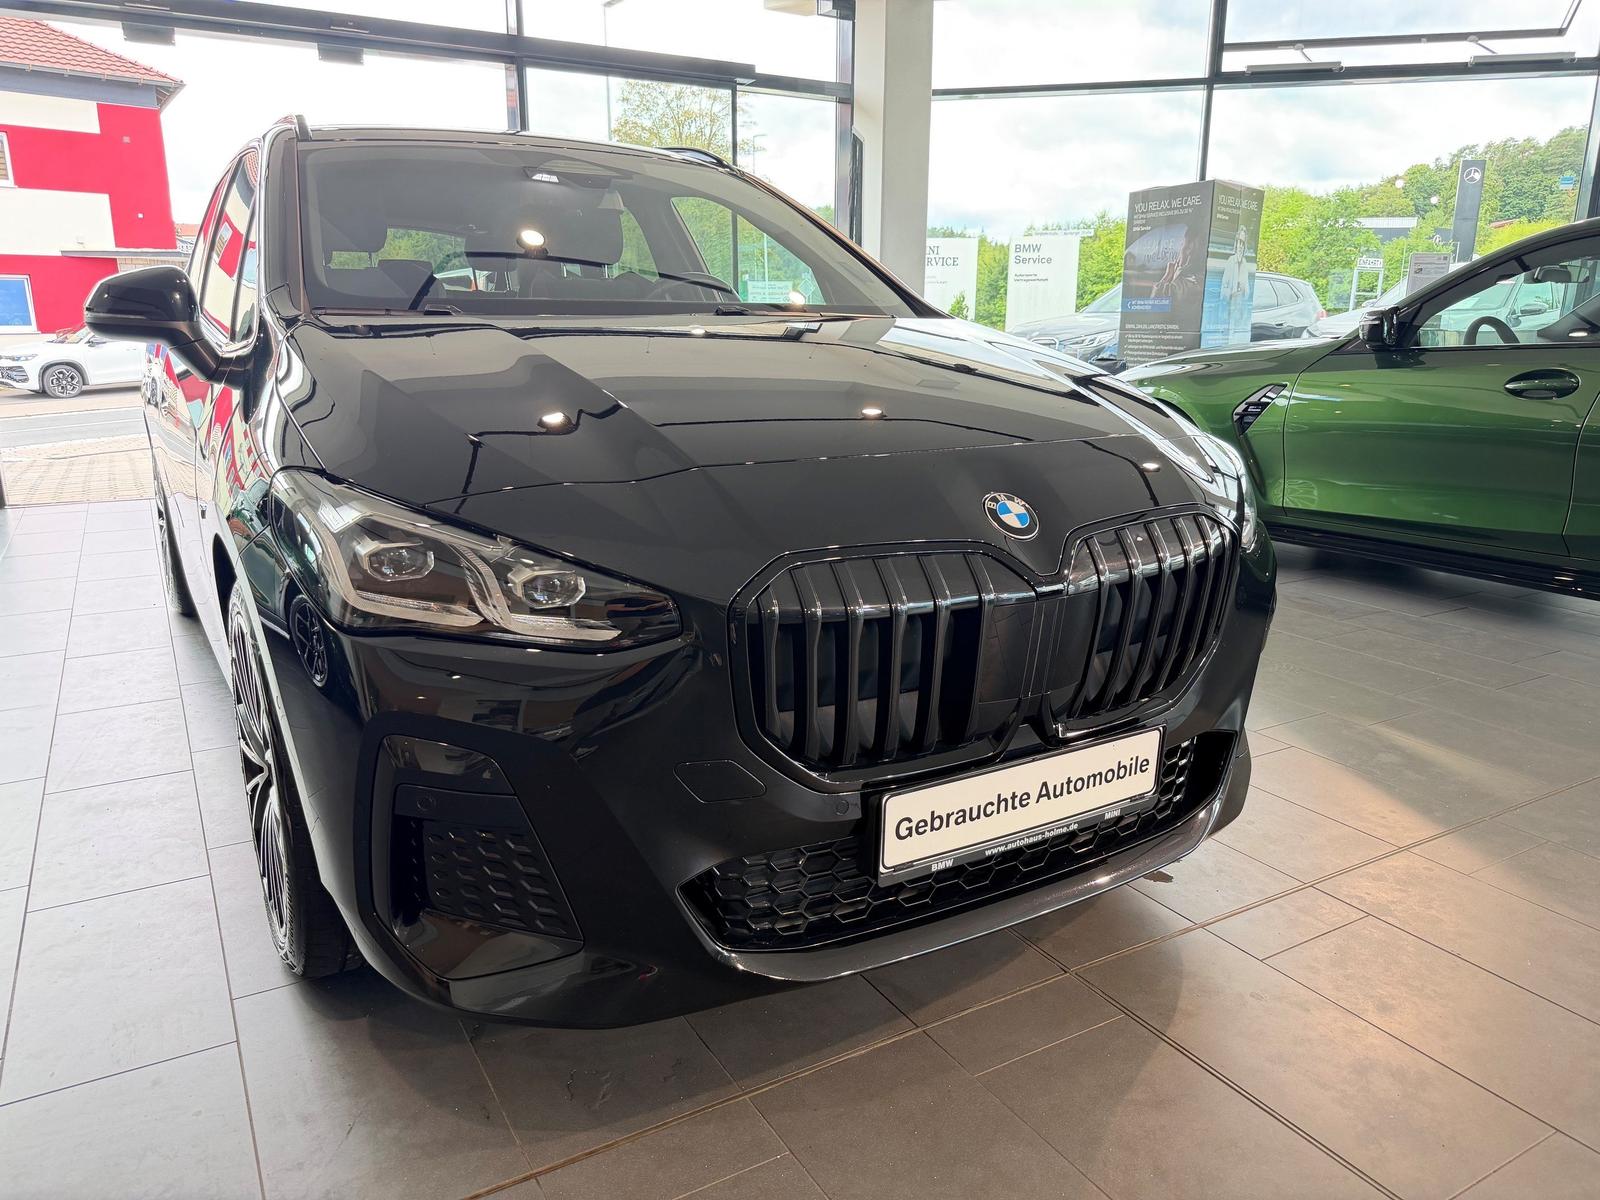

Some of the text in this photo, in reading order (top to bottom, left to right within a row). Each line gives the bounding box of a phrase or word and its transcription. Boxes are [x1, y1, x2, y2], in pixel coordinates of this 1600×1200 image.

[1134, 202, 1148, 213] YOU
[1172, 197, 1183, 209] WE
[927, 245, 940, 255] NI
[1014, 243, 1042, 253] BMW
[926, 256, 959, 267] RVICE
[1013, 255, 1053, 265] Service
[895, 755, 1150, 841] Gebrauchte Automobile
[931, 808, 1121, 872] BMW www.autohaus-holme.de MINI
